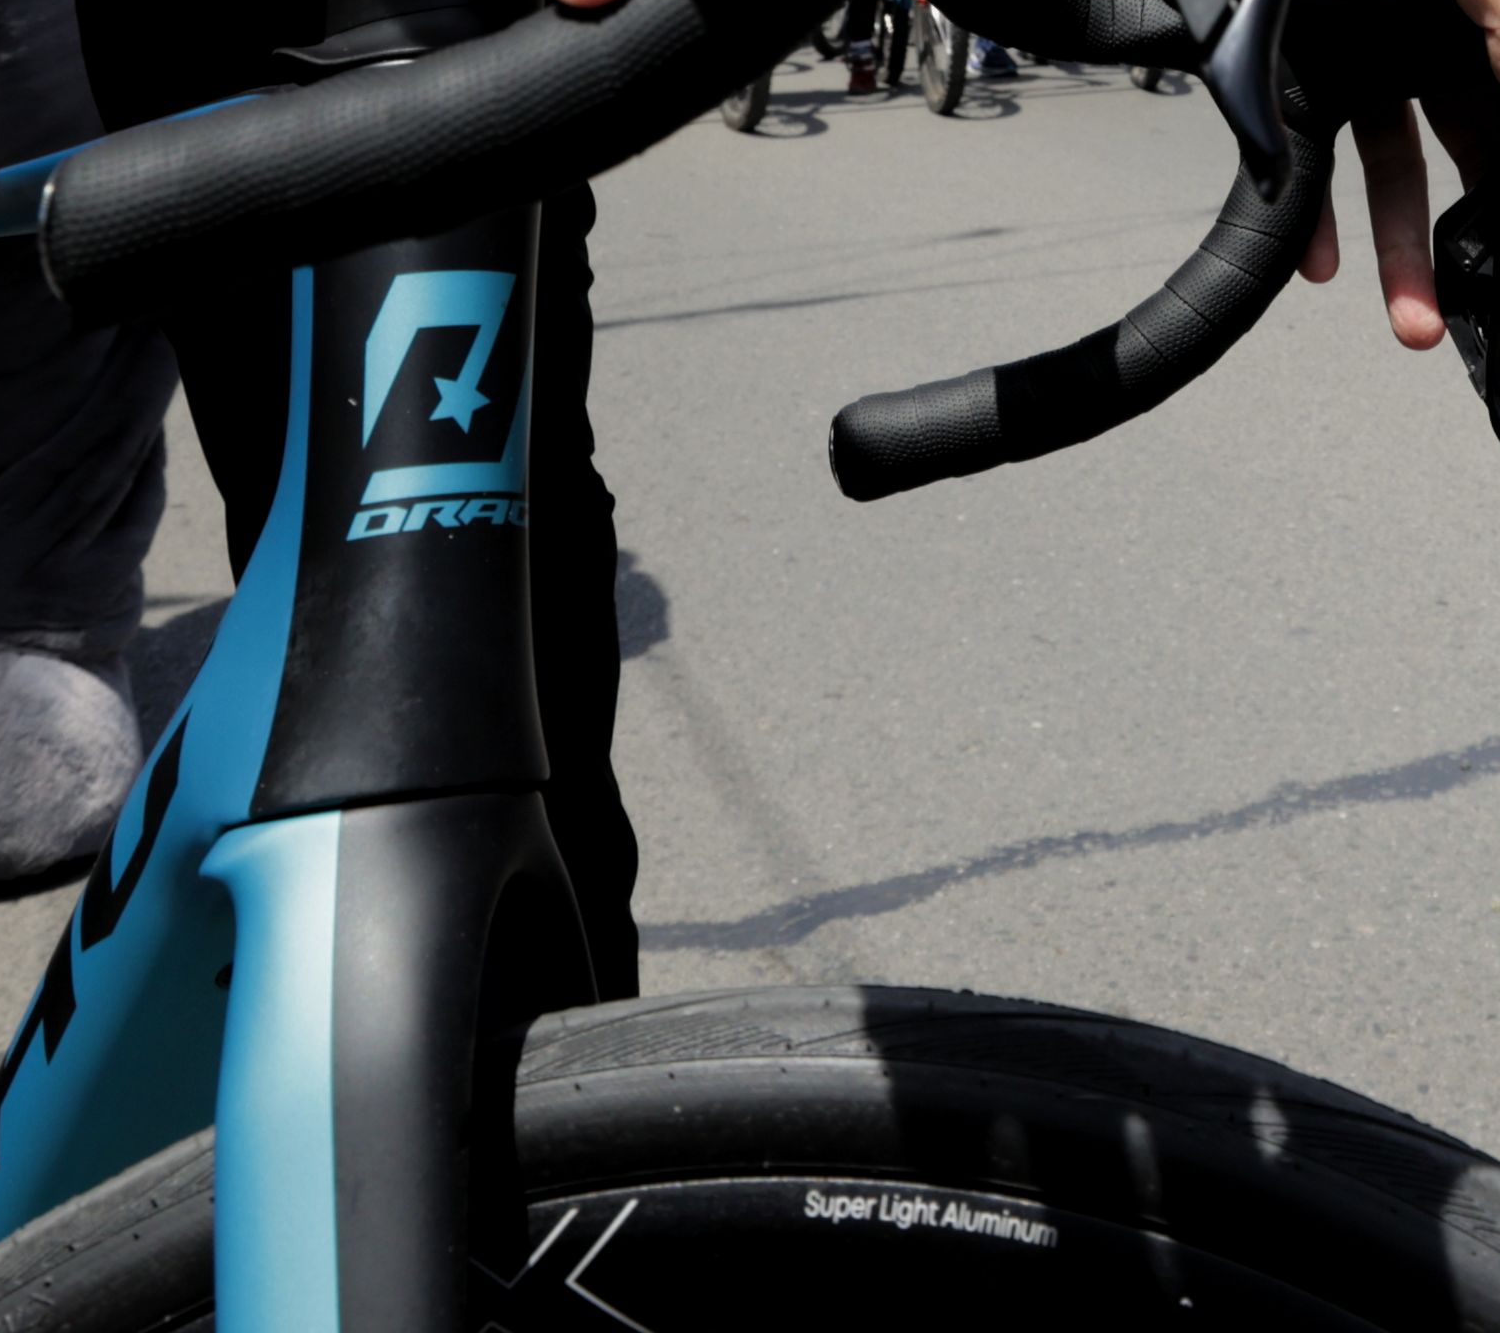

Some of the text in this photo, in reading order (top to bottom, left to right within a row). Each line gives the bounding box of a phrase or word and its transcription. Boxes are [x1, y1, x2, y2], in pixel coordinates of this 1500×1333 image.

[804, 1190, 1058, 1248] Super Light Aluminum
